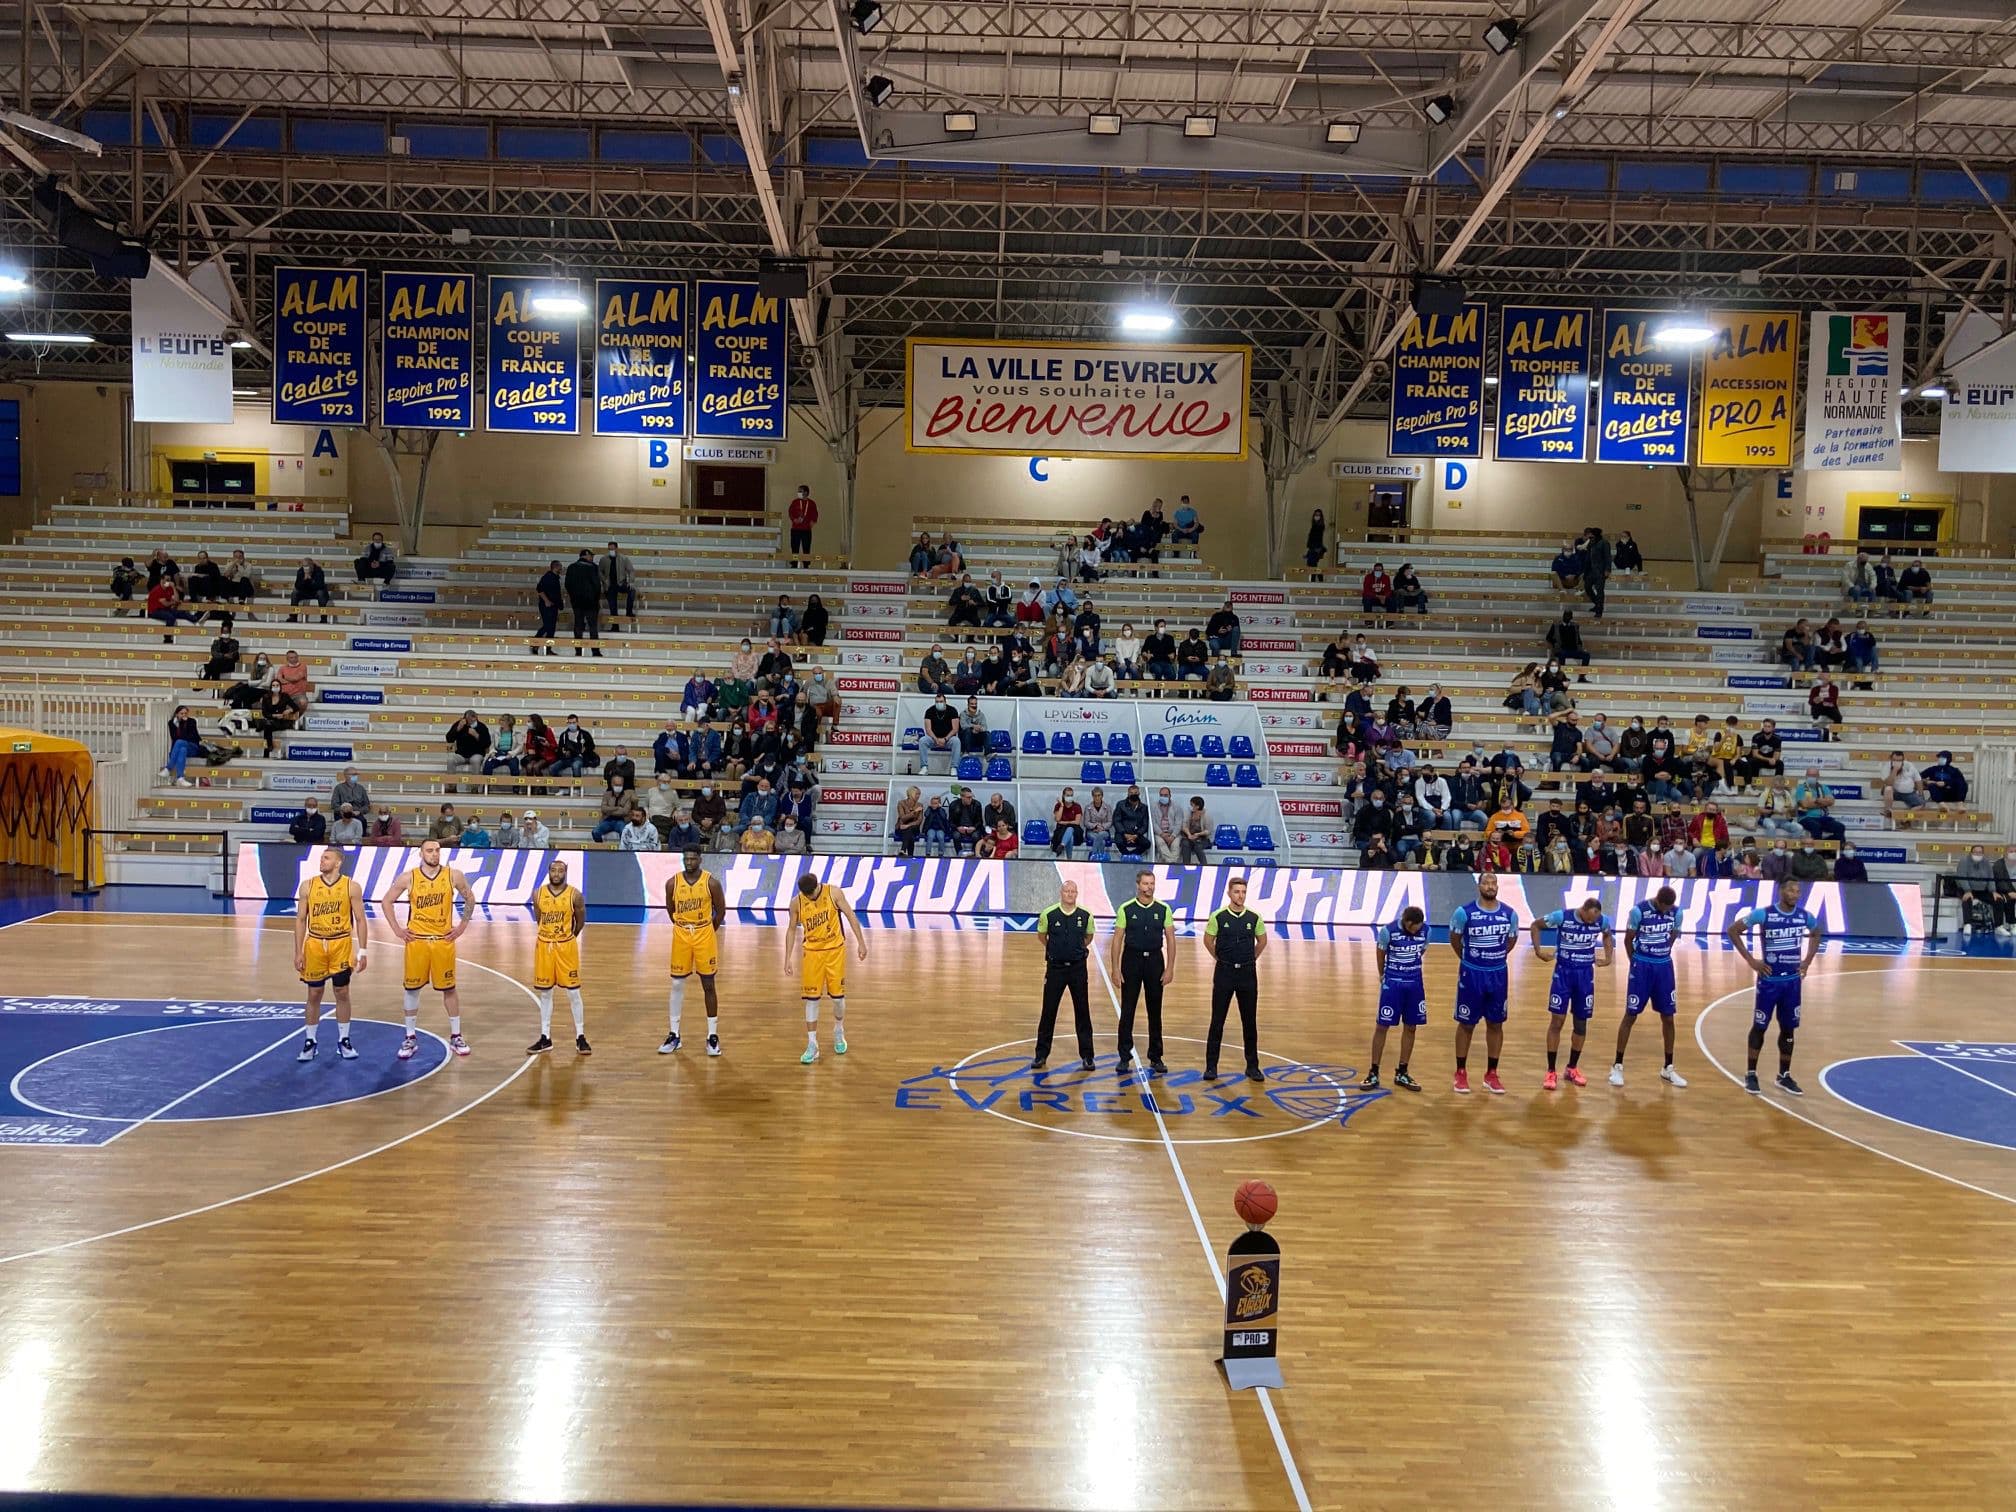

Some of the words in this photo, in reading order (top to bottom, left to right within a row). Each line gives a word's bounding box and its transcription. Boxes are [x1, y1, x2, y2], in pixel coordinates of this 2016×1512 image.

[281, 275, 358, 317] ALM
[389, 278, 465, 321] ALM
[602, 288, 678, 329] ALM
[702, 293, 778, 330] ALM
[293, 321, 347, 336] COUPE
[387, 326, 469, 340] CHAMPION
[1401, 309, 1478, 351] ALM
[1506, 314, 1583, 356] ALM
[310, 336, 330, 350] DE
[507, 330, 560, 344] COUPE
[600, 334, 682, 348] CHAMPION
[715, 336, 768, 350] COUPE
[1711, 319, 1788, 360] ALM
[418, 341, 438, 354] DE
[523, 345, 543, 358] DE
[630, 348, 650, 361] DE
[288, 350, 351, 365] FRANCE
[396, 355, 459, 370] FRANCE
[731, 351, 751, 363] DE
[1399, 356, 1480, 370] CHAMPION
[501, 359, 565, 374] FRANCE
[609, 362, 672, 377] FRANCE
[709, 365, 772, 379] FRANCE
[942, 357, 979, 379] LA
[987, 357, 1063, 381] VILLE
[1074, 360, 1218, 384] D'EVREUX
[1510, 360, 1579, 373] TROPHEE
[1620, 363, 1672, 377] COUPE
[1428, 371, 1448, 384] DE
[1532, 374, 1556, 387] DU
[1635, 378, 1655, 390] DE
[1710, 378, 1787, 390] ACCESSION
[1825, 377, 1888, 388] REGION
[281, 370, 358, 402] Cadets
[387, 383, 433, 402] Espoirs
[436, 378, 457, 395] Pro
[460, 374, 469, 387] B
[494, 378, 572, 408] Cadets
[973, 384, 1029, 396] vous
[1040, 383, 1146, 399] souhaite
[1156, 386, 1175, 399] la
[1406, 385, 1469, 399] FRANCE
[600, 389, 646, 411] Espoirs
[649, 384, 670, 401] Pro
[673, 380, 682, 395] B
[702, 383, 779, 413] Cadets
[1518, 389, 1567, 402] FUTUR
[1613, 392, 1676, 406] FRANCE
[1824, 390, 1887, 404] HAUTE
[321, 403, 353, 415] 1973
[428, 407, 462, 419] 1992
[1395, 410, 1442, 432] Espoirs
[1445, 405, 1466, 422] Pro
[1468, 400, 1478, 415] B
[1708, 398, 1761, 430] PRO
[1770, 395, 1787, 422] A
[1823, 405, 1886, 420] NORMANDIE
[532, 411, 566, 424] 1992
[640, 415, 674, 427] 1993
[740, 417, 774, 430] 1993
[925, 395, 1230, 438] Bienvenue
[1504, 404, 1577, 435] Espoirs
[1604, 409, 1682, 440] Cadets
[1824, 425, 1883, 439] Partenaire
[312, 429, 338, 458] A
[1436, 436, 1469, 448] 1994
[1541, 440, 1574, 453] 1994
[1813, 443, 1827, 455] de
[1829, 442, 1840, 454] la
[1842, 437, 1894, 452] formation
[649, 440, 669, 469] B
[694, 448, 724, 459] CLUB
[727, 448, 764, 459] EBENE
[1642, 443, 1675, 456] 1994
[1745, 445, 1775, 457] 1995
[1821, 454, 1840, 468] des
[1847, 451, 1884, 468] jeunes
[1029, 457, 1049, 482] C
[1343, 465, 1372, 474] CLUB
[1376, 466, 1412, 476] EBENE
[1445, 462, 1467, 490] D
[1777, 472, 1793, 498] E
[853, 584, 869, 592] SOS
[870, 585, 904, 593] INTERIM
[1232, 593, 1248, 601] SOS
[1249, 594, 1283, 603] INTERIM
[847, 631, 864, 639] SOS
[865, 631, 900, 640] INTERIM
[1242, 640, 1258, 649] SOS
[1260, 641, 1295, 649] INTERIM
[840, 680, 857, 688] SOS
[859, 680, 895, 689] INTERIM
[1252, 690, 1269, 698] SOS
[1271, 691, 1308, 699] INTERIM
[832, 734, 850, 742] SOS
[852, 734, 890, 743] INTERIM
[1268, 744, 1282, 752] OS
[1284, 745, 1322, 754] INTERIM
[823, 792, 842, 800] SOS
[844, 792, 884, 801] INTERIM
[1298, 803, 1339, 813] INTERIM
[331, 917, 341, 925] 13
[554, 926, 565, 934] 24
[30, 1001, 121, 1012] dalkia
[218, 1004, 306, 1015] dalkia
[895, 1087, 1264, 1118] EVREUX
